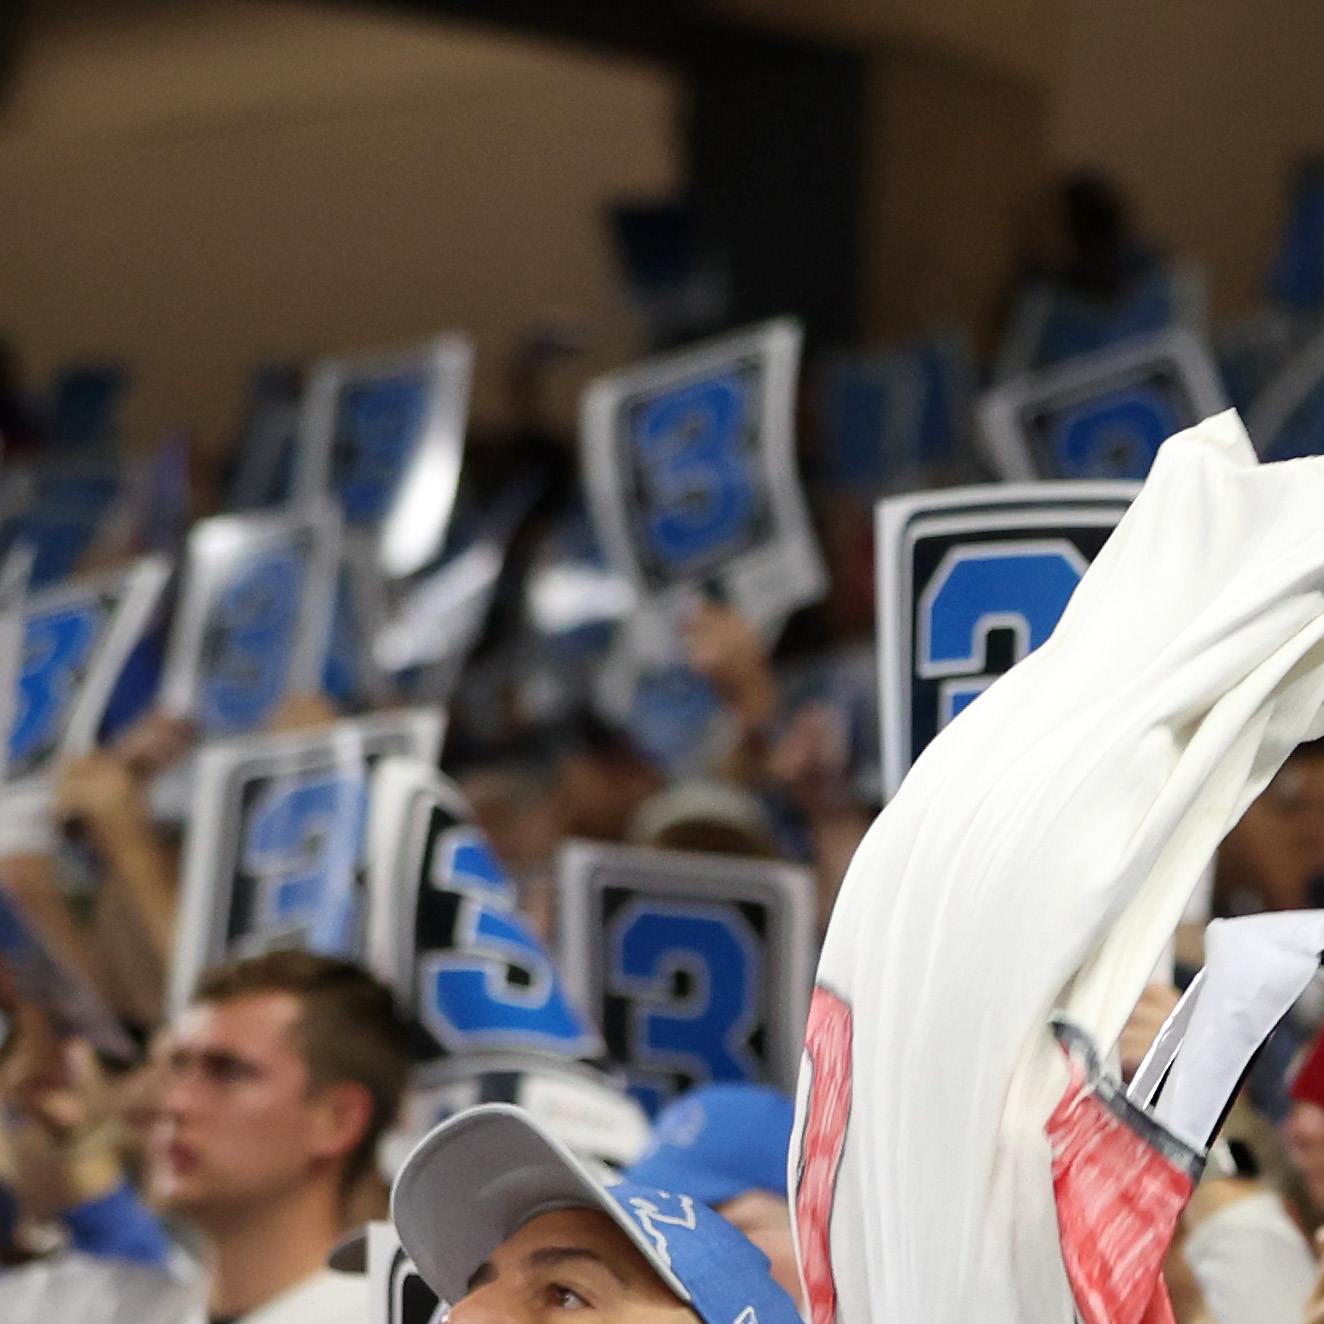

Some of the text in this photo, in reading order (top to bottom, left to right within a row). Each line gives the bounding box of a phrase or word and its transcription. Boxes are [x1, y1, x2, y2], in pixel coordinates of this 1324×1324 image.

[632, 366, 762, 570] 3
[420, 824, 602, 1058] 3
[612, 901, 766, 1114] 3
